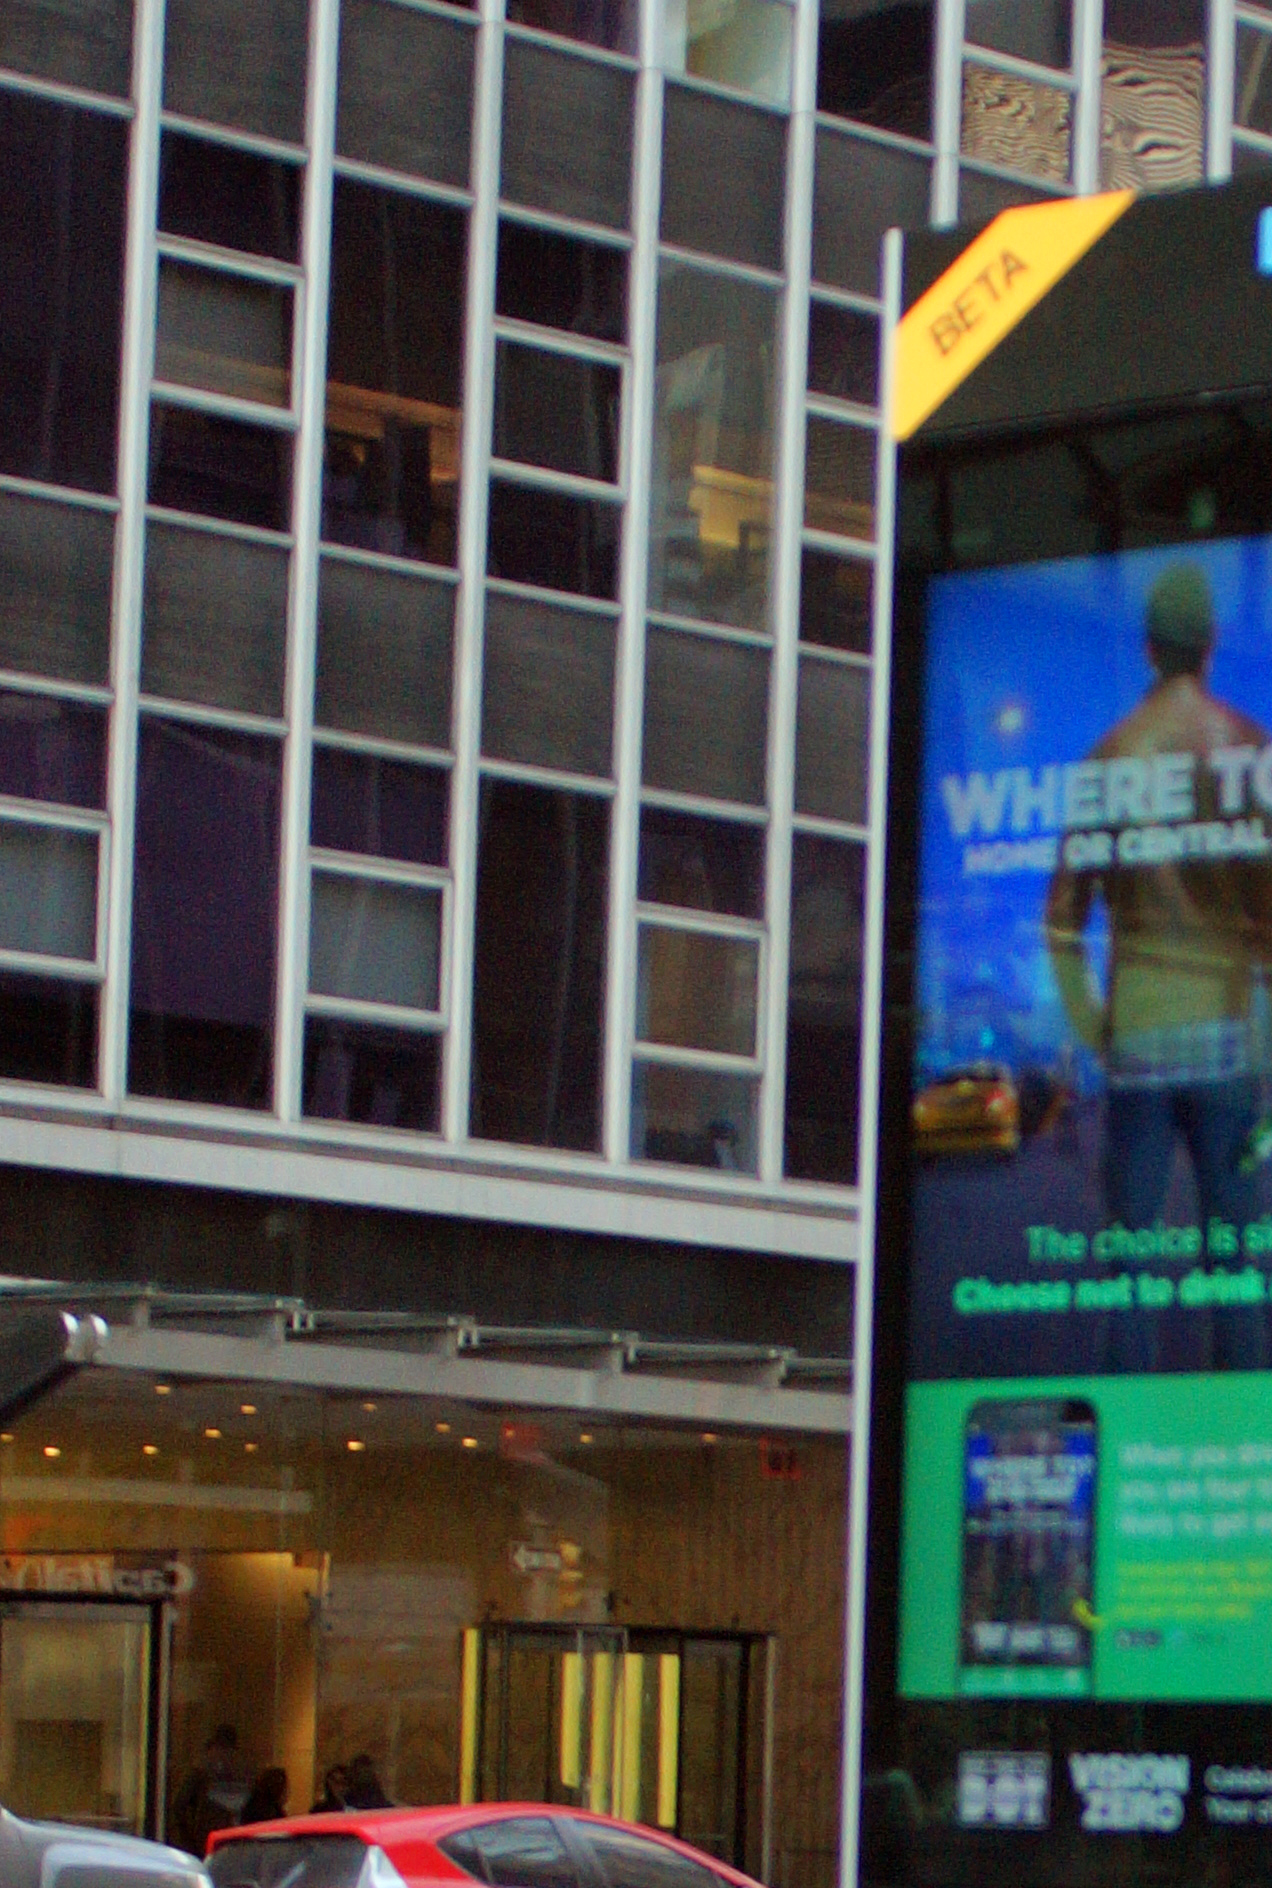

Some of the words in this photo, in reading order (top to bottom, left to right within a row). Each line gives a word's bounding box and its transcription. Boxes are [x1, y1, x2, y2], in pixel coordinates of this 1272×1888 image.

[929, 248, 1028, 356] BETA
[942, 752, 1195, 836] WHERE
[964, 838, 1057, 876] HOME
[1063, 830, 1112, 869] OR
[1117, 819, 1272, 862] CENTRAL
[1025, 1226, 1087, 1263] The
[1093, 1222, 1201, 1260] choice
[1207, 1215, 1238, 1257] is
[953, 1276, 1071, 1314] Choose
[1075, 1273, 1132, 1310] not
[1137, 1272, 1173, 1307] to
[1178, 1265, 1265, 1308] drink
[1068, 1752, 1191, 1793] VISION
[1081, 1791, 1185, 1833] ZERO
